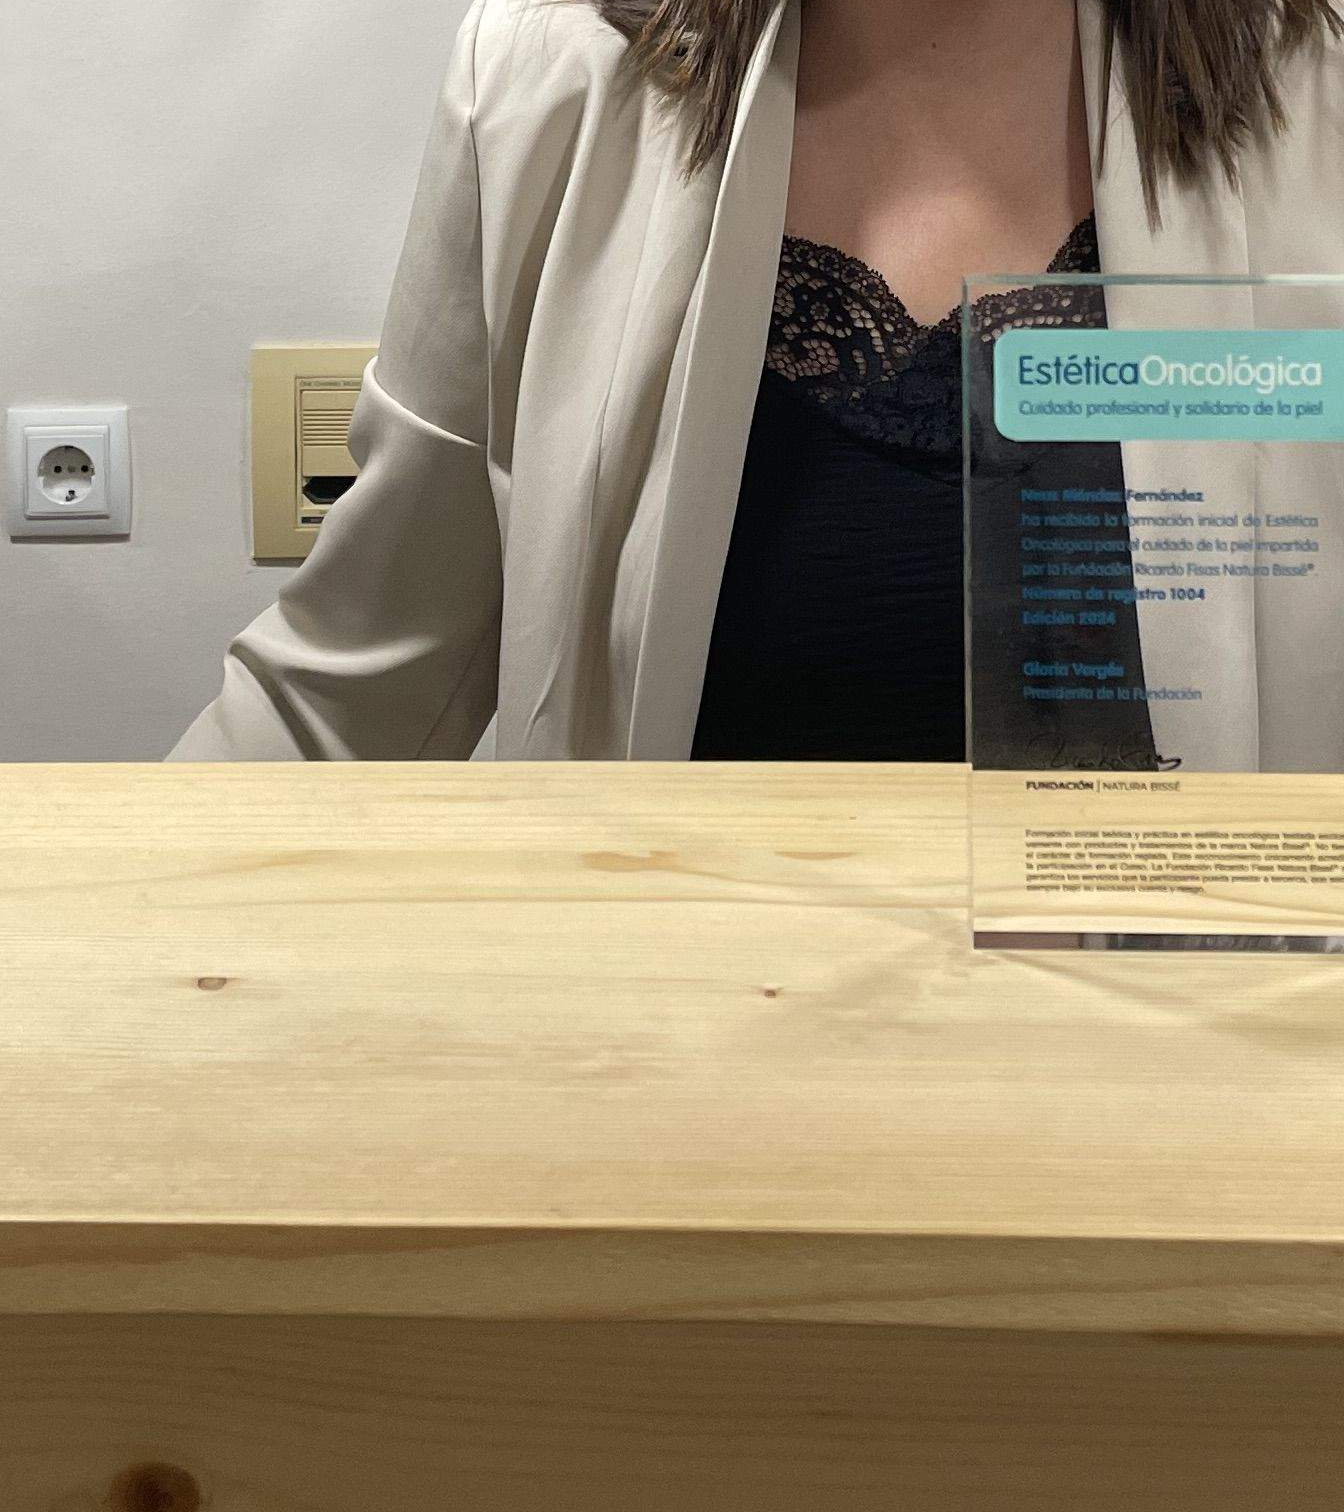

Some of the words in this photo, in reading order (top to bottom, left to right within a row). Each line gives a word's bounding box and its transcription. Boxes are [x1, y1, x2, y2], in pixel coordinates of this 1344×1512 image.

[1019, 400, 1082, 415] Cuidado
[1086, 399, 1169, 418] profesional
[1173, 403, 1183, 418] y
[1185, 399, 1250, 415] solidario
[1253, 400, 1273, 415] de
[1277, 400, 1291, 415] la
[1295, 400, 1323, 417] piel
[1126, 488, 1205, 502] Fernández
[1121, 513, 1194, 527] formación
[1198, 513, 1238, 527] inicial
[1242, 513, 1261, 527] de
[1265, 513, 1319, 528] Estética
[1142, 538, 1193, 552] cuidado
[1197, 538, 1214, 552] de
[1216, 538, 1228, 552] la
[1230, 538, 1255, 554] piel
[1256, 538, 1318, 554] impartida
[1135, 562, 1184, 577] Ricardo
[1186, 562, 1219, 577] Fisas
[1223, 562, 1269, 577] Natura
[1085, 587, 1103, 601] de
[1108, 587, 1167, 604] registro
[1170, 587, 1206, 601] 1004
[1096, 685, 1114, 700] de
[1117, 686, 1130, 700] la
[1133, 685, 1202, 700] Fundación
[1026, 780, 1094, 791] FUNDACIÓN
[1102, 781, 1147, 792] NATURA
